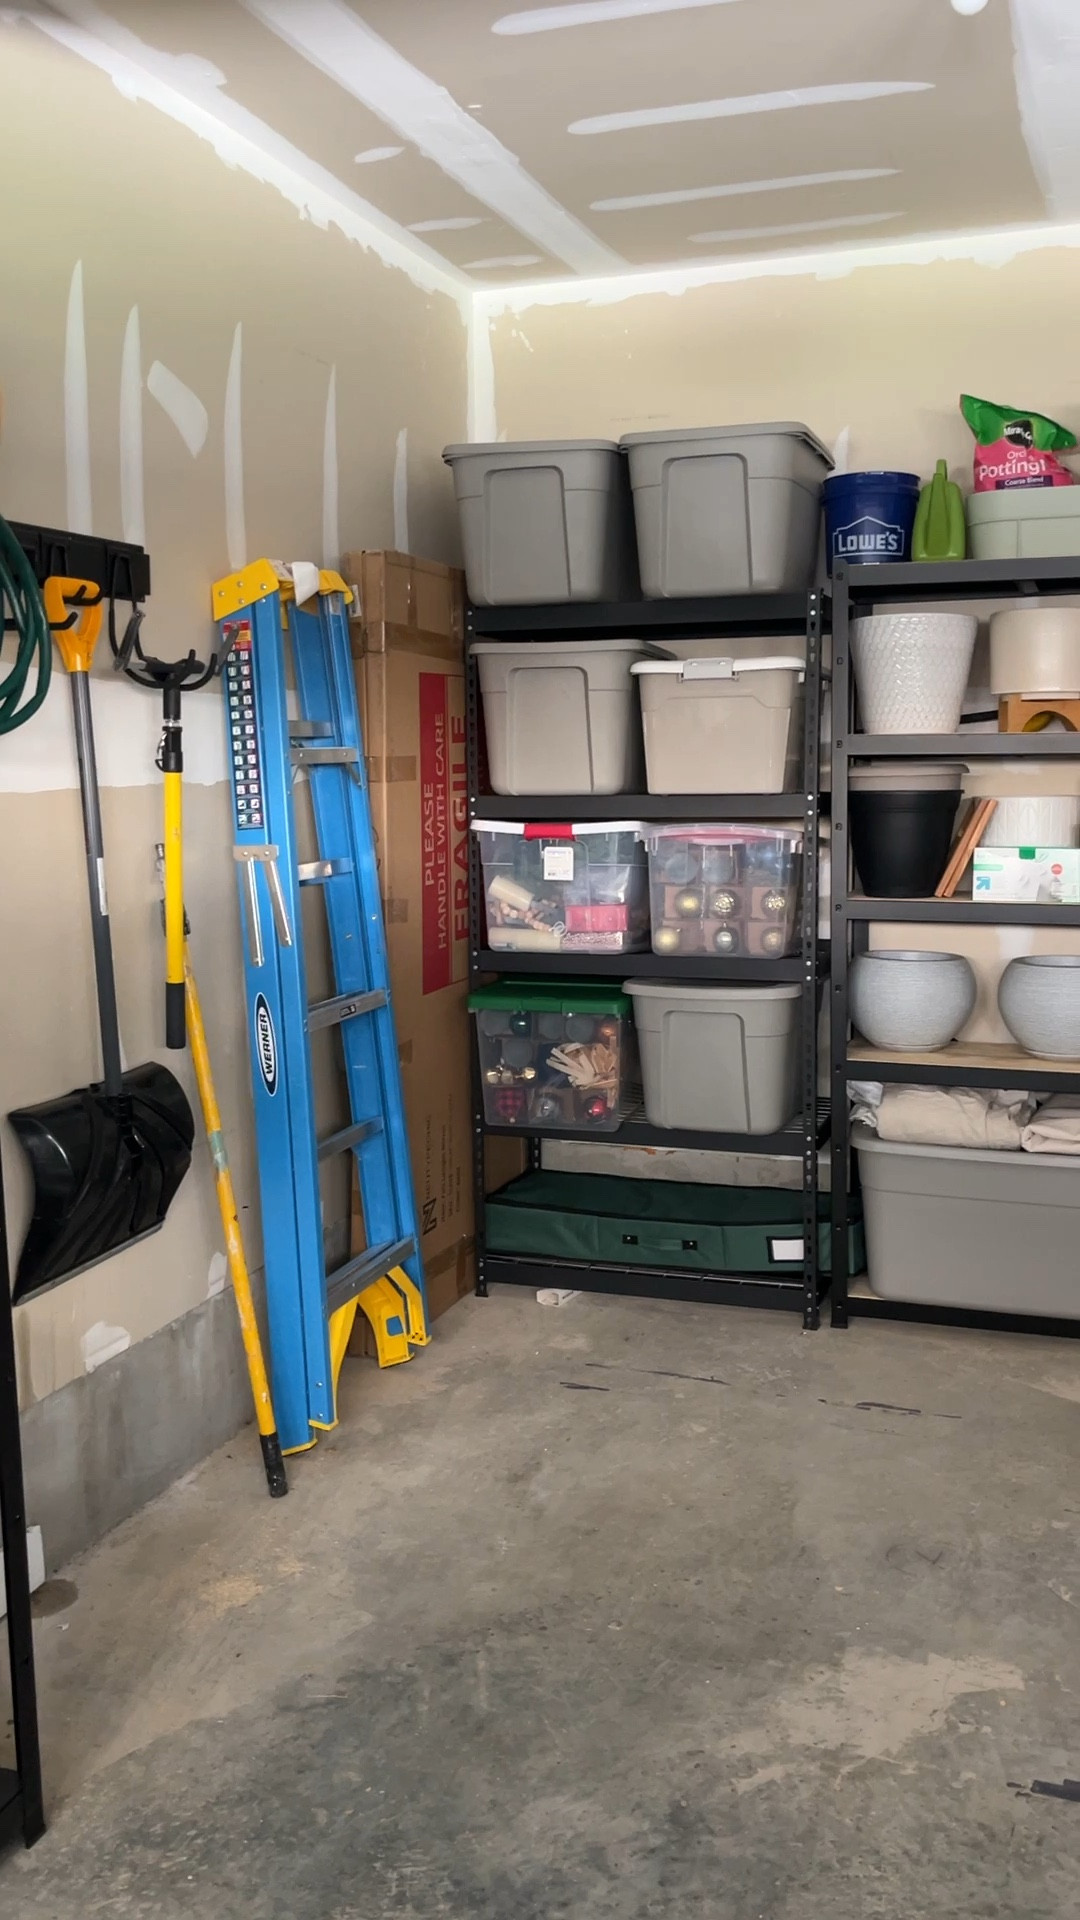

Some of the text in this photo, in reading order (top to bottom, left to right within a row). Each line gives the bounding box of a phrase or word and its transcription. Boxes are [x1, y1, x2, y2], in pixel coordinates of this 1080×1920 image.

[979, 459, 1041, 481] Potting
[838, 532, 898, 553] LOWE'S
[423, 783, 435, 886] PLEASE
[434, 713, 447, 949] HANDLE WITH CARE
[451, 715, 470, 941] FRAGILE
[259, 1012, 274, 1075] WERNER
